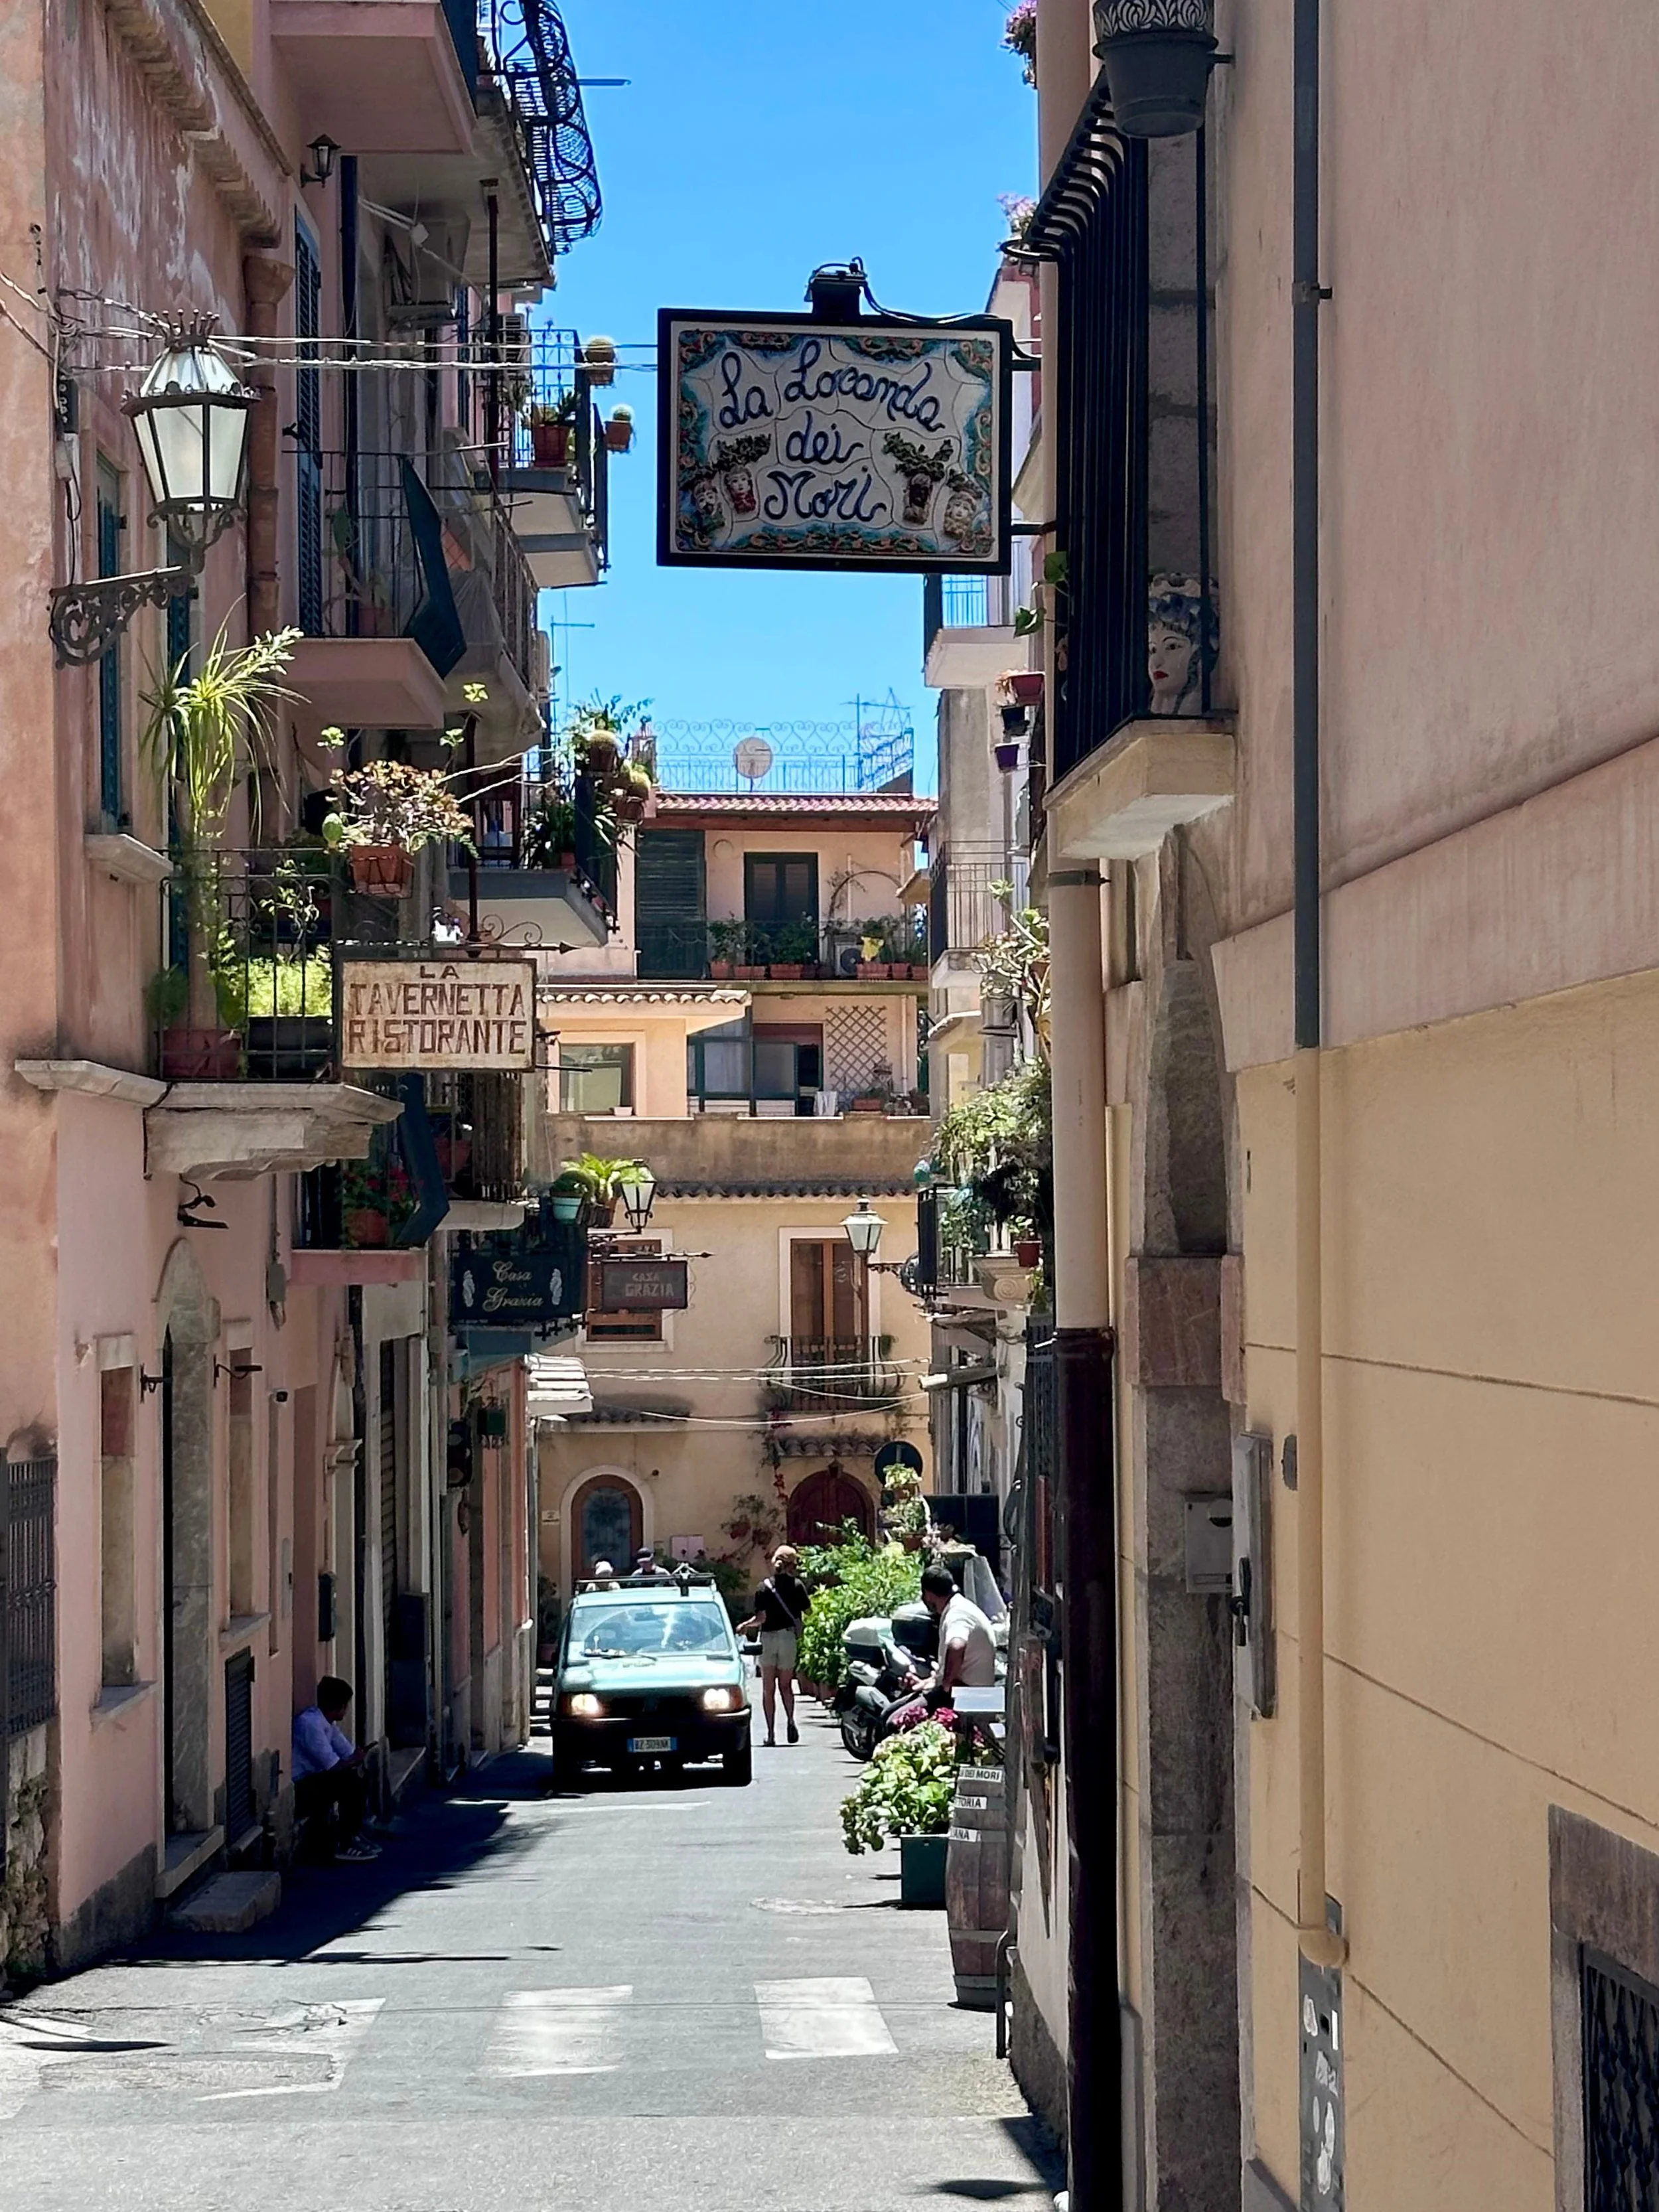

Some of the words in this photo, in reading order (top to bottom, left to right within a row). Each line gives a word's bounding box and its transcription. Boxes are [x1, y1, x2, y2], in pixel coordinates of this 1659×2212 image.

[719, 351, 774, 429] La
[784, 339, 946, 432] Locanda
[786, 411, 864, 465] dei
[764, 466, 887, 522] Mori
[419, 964, 460, 980] LA
[350, 983, 526, 1017] TAVERNETTA
[348, 1019, 527, 1055] RISTORANTE
[492, 1260, 533, 1283] Casa
[482, 1286, 544, 1312] Grazia
[624, 1282, 674, 1297] GRAZIA
[976, 1769, 1000, 1781] MORI
